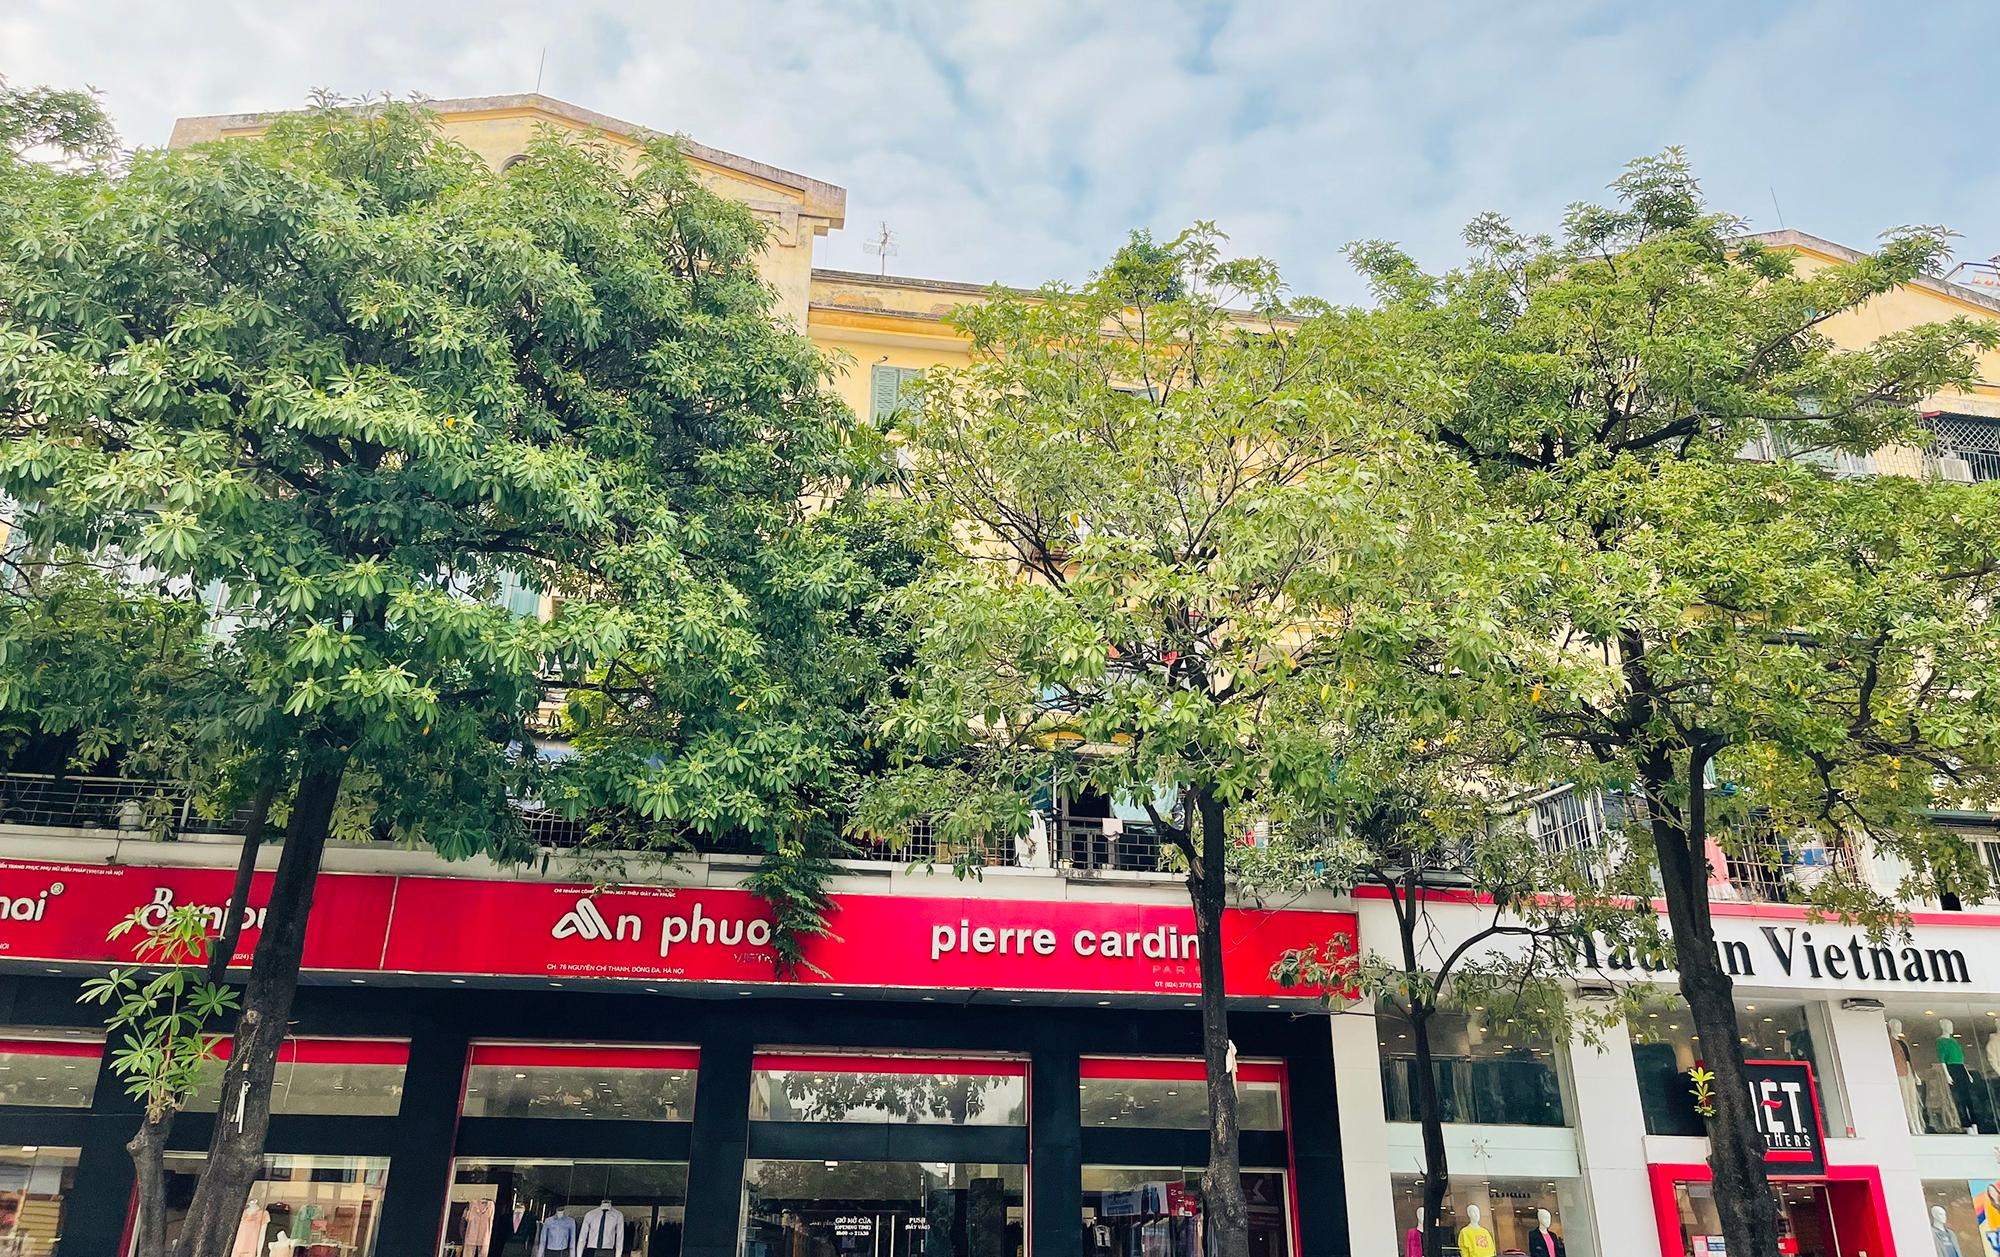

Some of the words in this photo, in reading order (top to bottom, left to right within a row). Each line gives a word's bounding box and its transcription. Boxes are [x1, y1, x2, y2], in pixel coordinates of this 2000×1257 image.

[660, 902, 771, 957] phuo
[931, 919, 1057, 960] pierre
[1074, 926, 1201, 960] cardin
[1759, 926, 1972, 983] Vietnam
[1764, 1133, 1811, 1147] THERS
